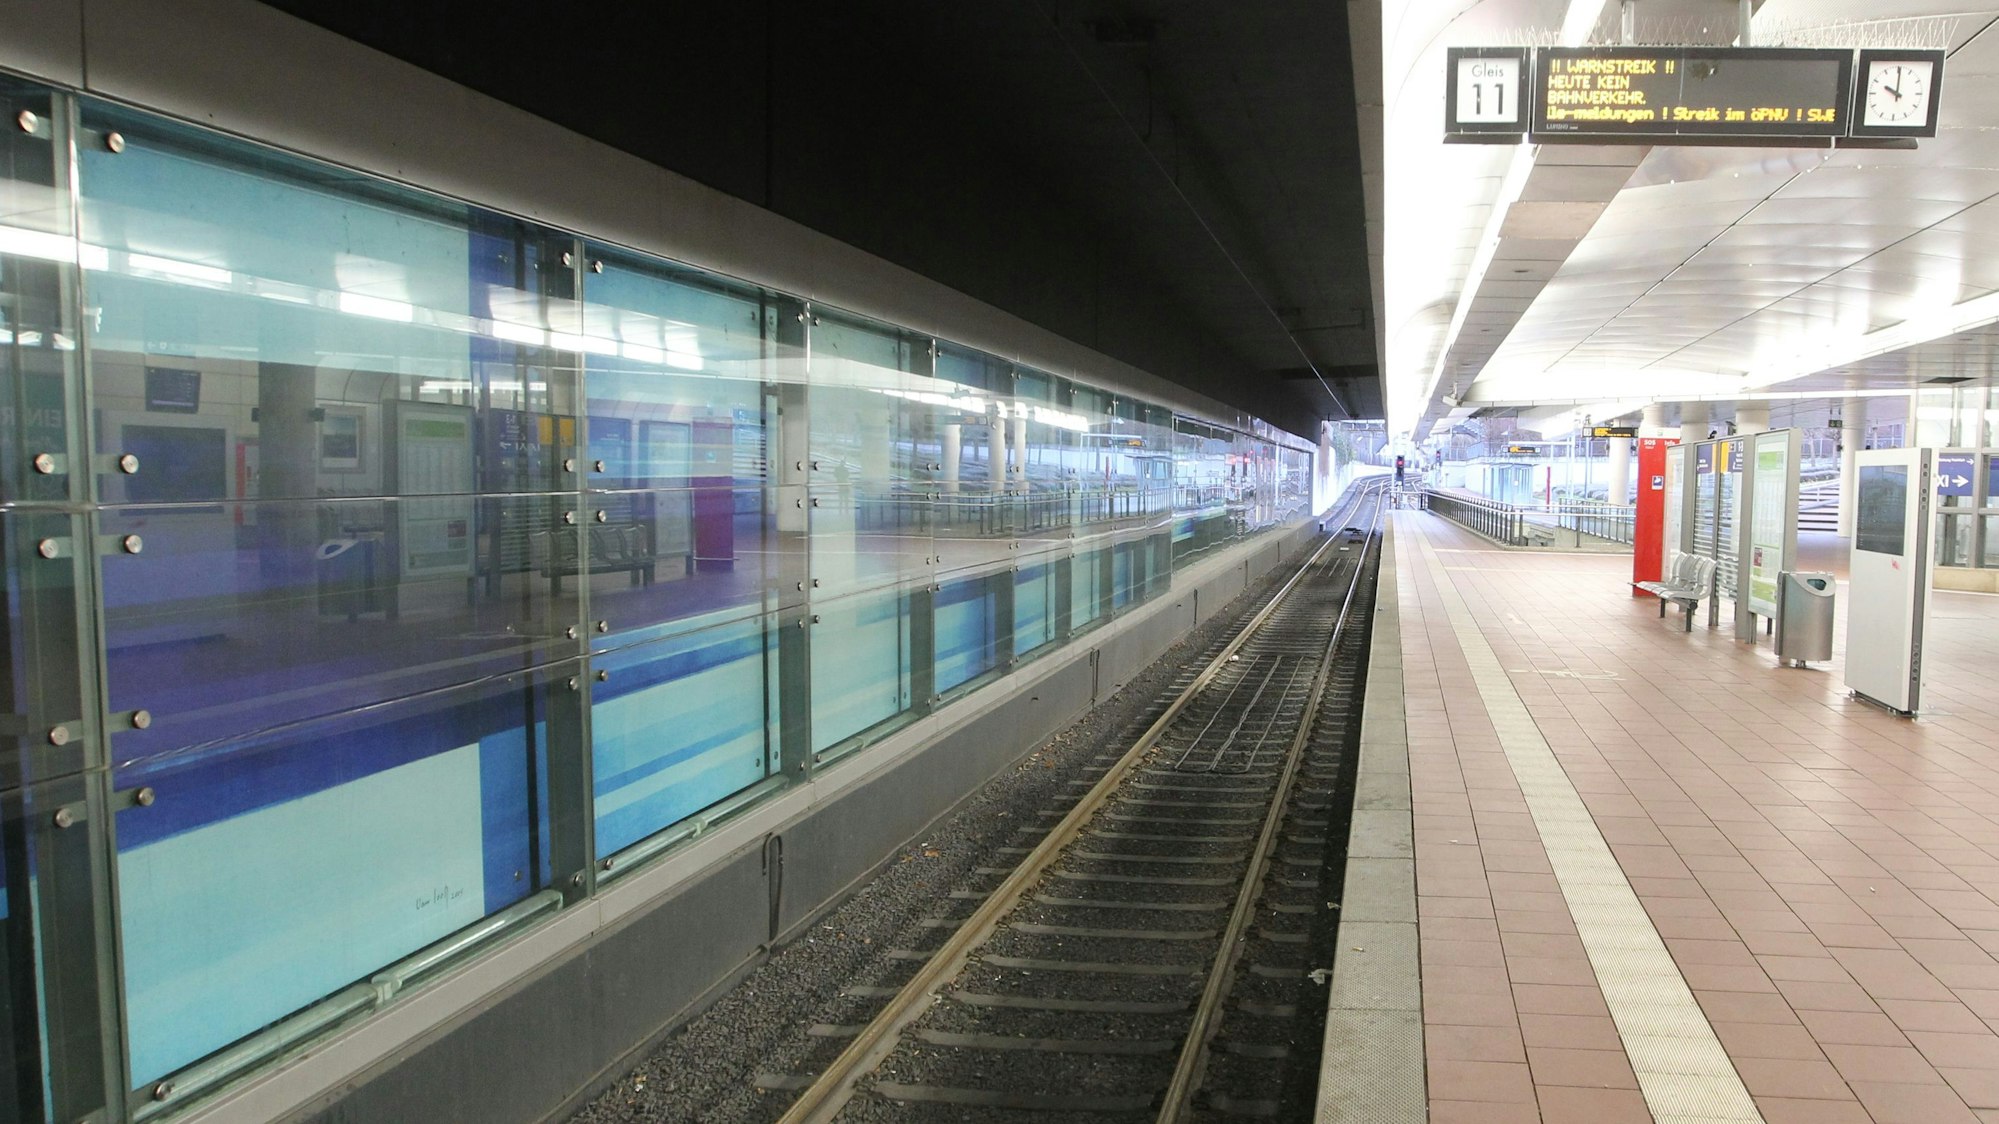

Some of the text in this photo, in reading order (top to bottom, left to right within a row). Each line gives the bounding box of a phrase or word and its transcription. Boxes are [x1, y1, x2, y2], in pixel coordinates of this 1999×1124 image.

[1471, 61, 1504, 78] Gleis
[1567, 59, 1656, 74] WARNSTREIK
[1548, 75, 1630, 89] HEUTE KEIN
[1472, 83, 1504, 115] 11
[1547, 90, 1647, 105] BAHNVERKEHR.
[1673, 106, 1720, 121] Streik
[1725, 107, 1746, 121] im
